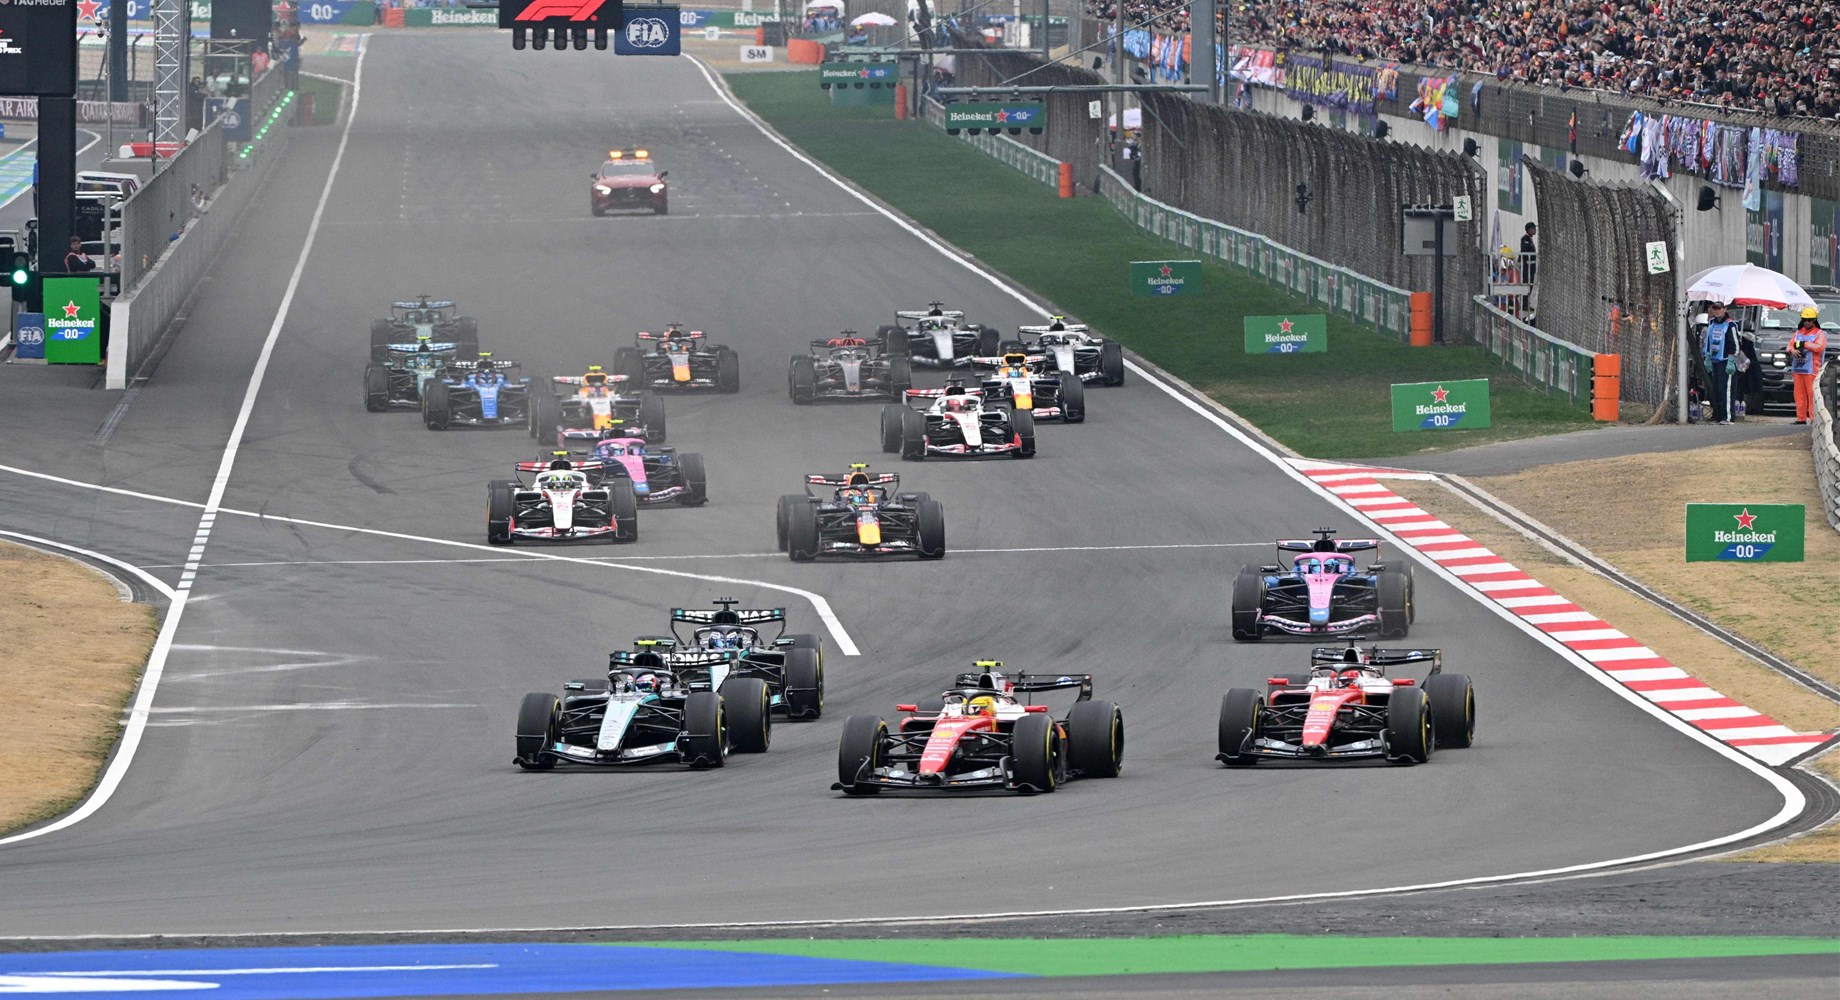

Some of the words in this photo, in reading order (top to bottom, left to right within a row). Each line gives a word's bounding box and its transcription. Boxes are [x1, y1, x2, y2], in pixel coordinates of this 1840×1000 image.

[432, 10, 497, 23] Heineken
[950, 112, 993, 121] Heineken
[1147, 277, 1184, 285] Heineken
[48, 318, 94, 328] Heineken
[1265, 333, 1307, 342] Heineken
[1415, 403, 1466, 415] Heineken
[1714, 530, 1776, 543] Heineken
[684, 610, 772, 622] PETNAS
